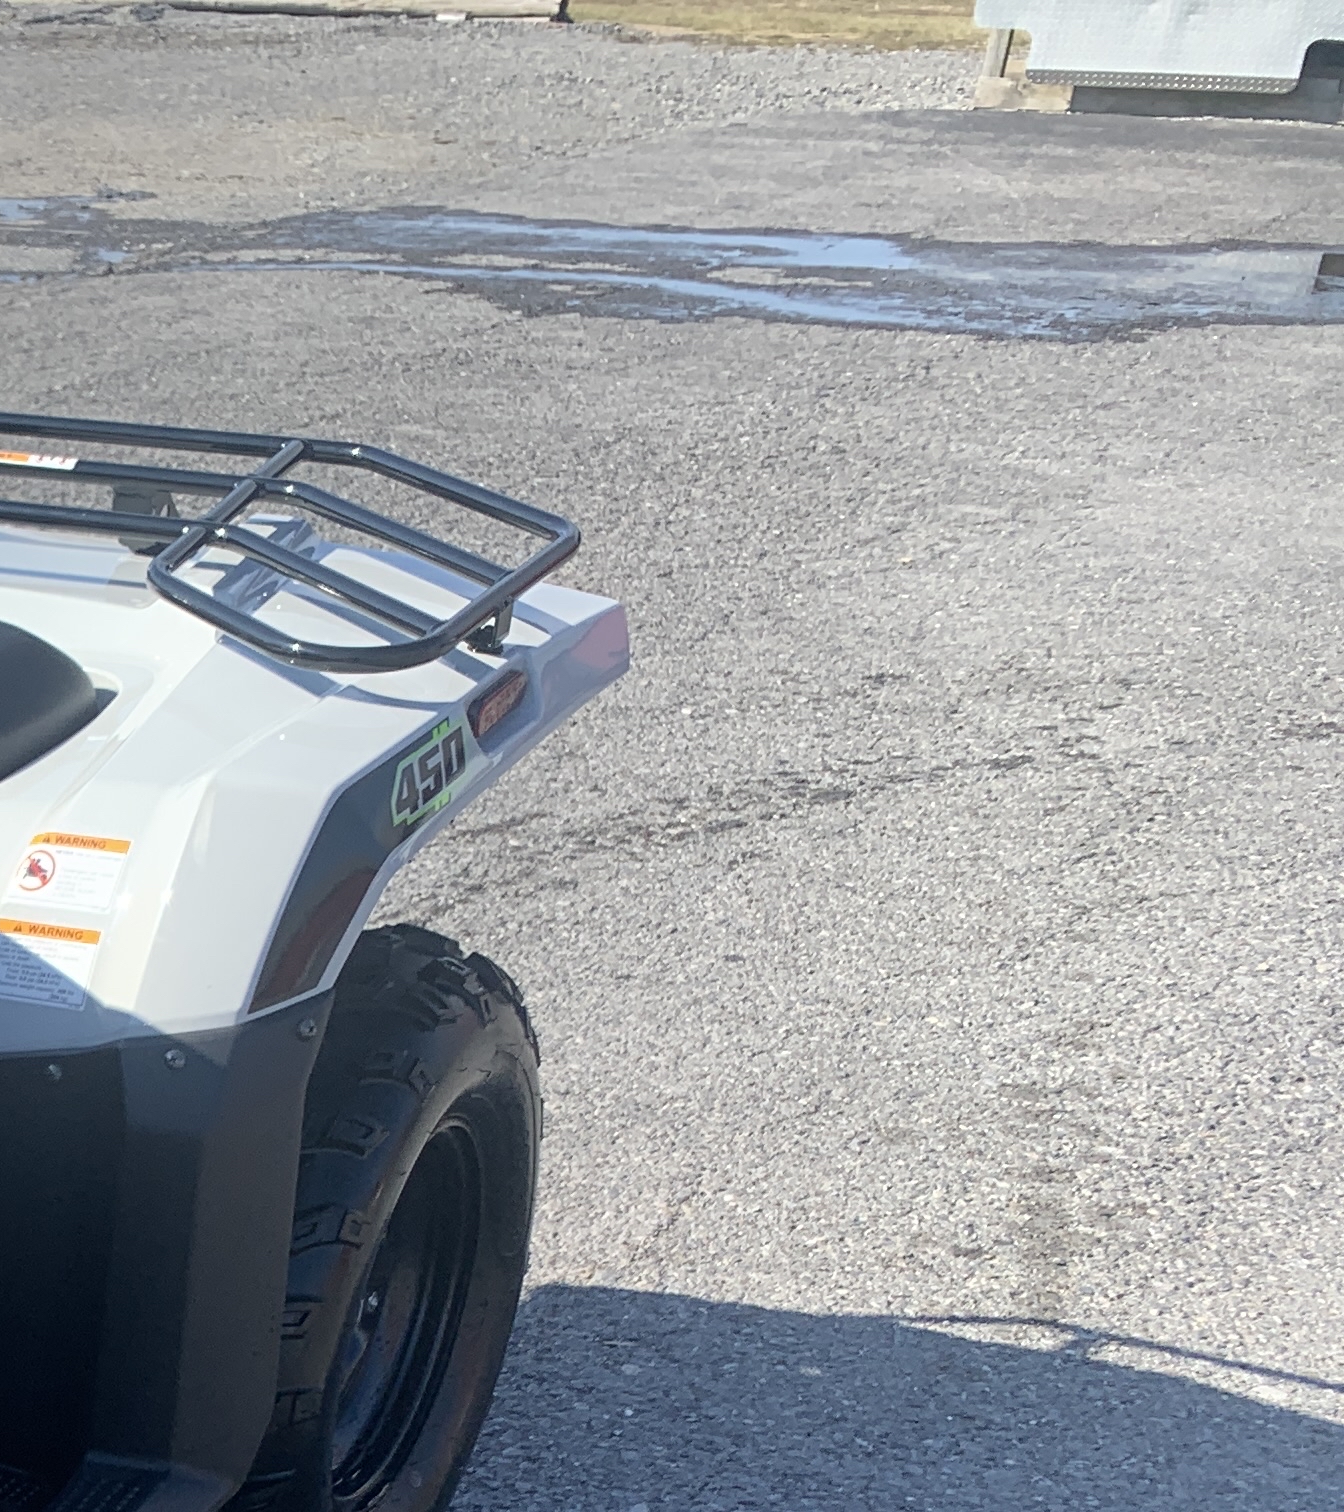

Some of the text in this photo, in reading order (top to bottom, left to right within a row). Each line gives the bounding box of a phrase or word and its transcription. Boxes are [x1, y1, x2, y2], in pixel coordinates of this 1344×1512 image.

[394, 726, 466, 816] 450
[55, 835, 107, 850] WARNING
[28, 924, 84, 941] WARNING
